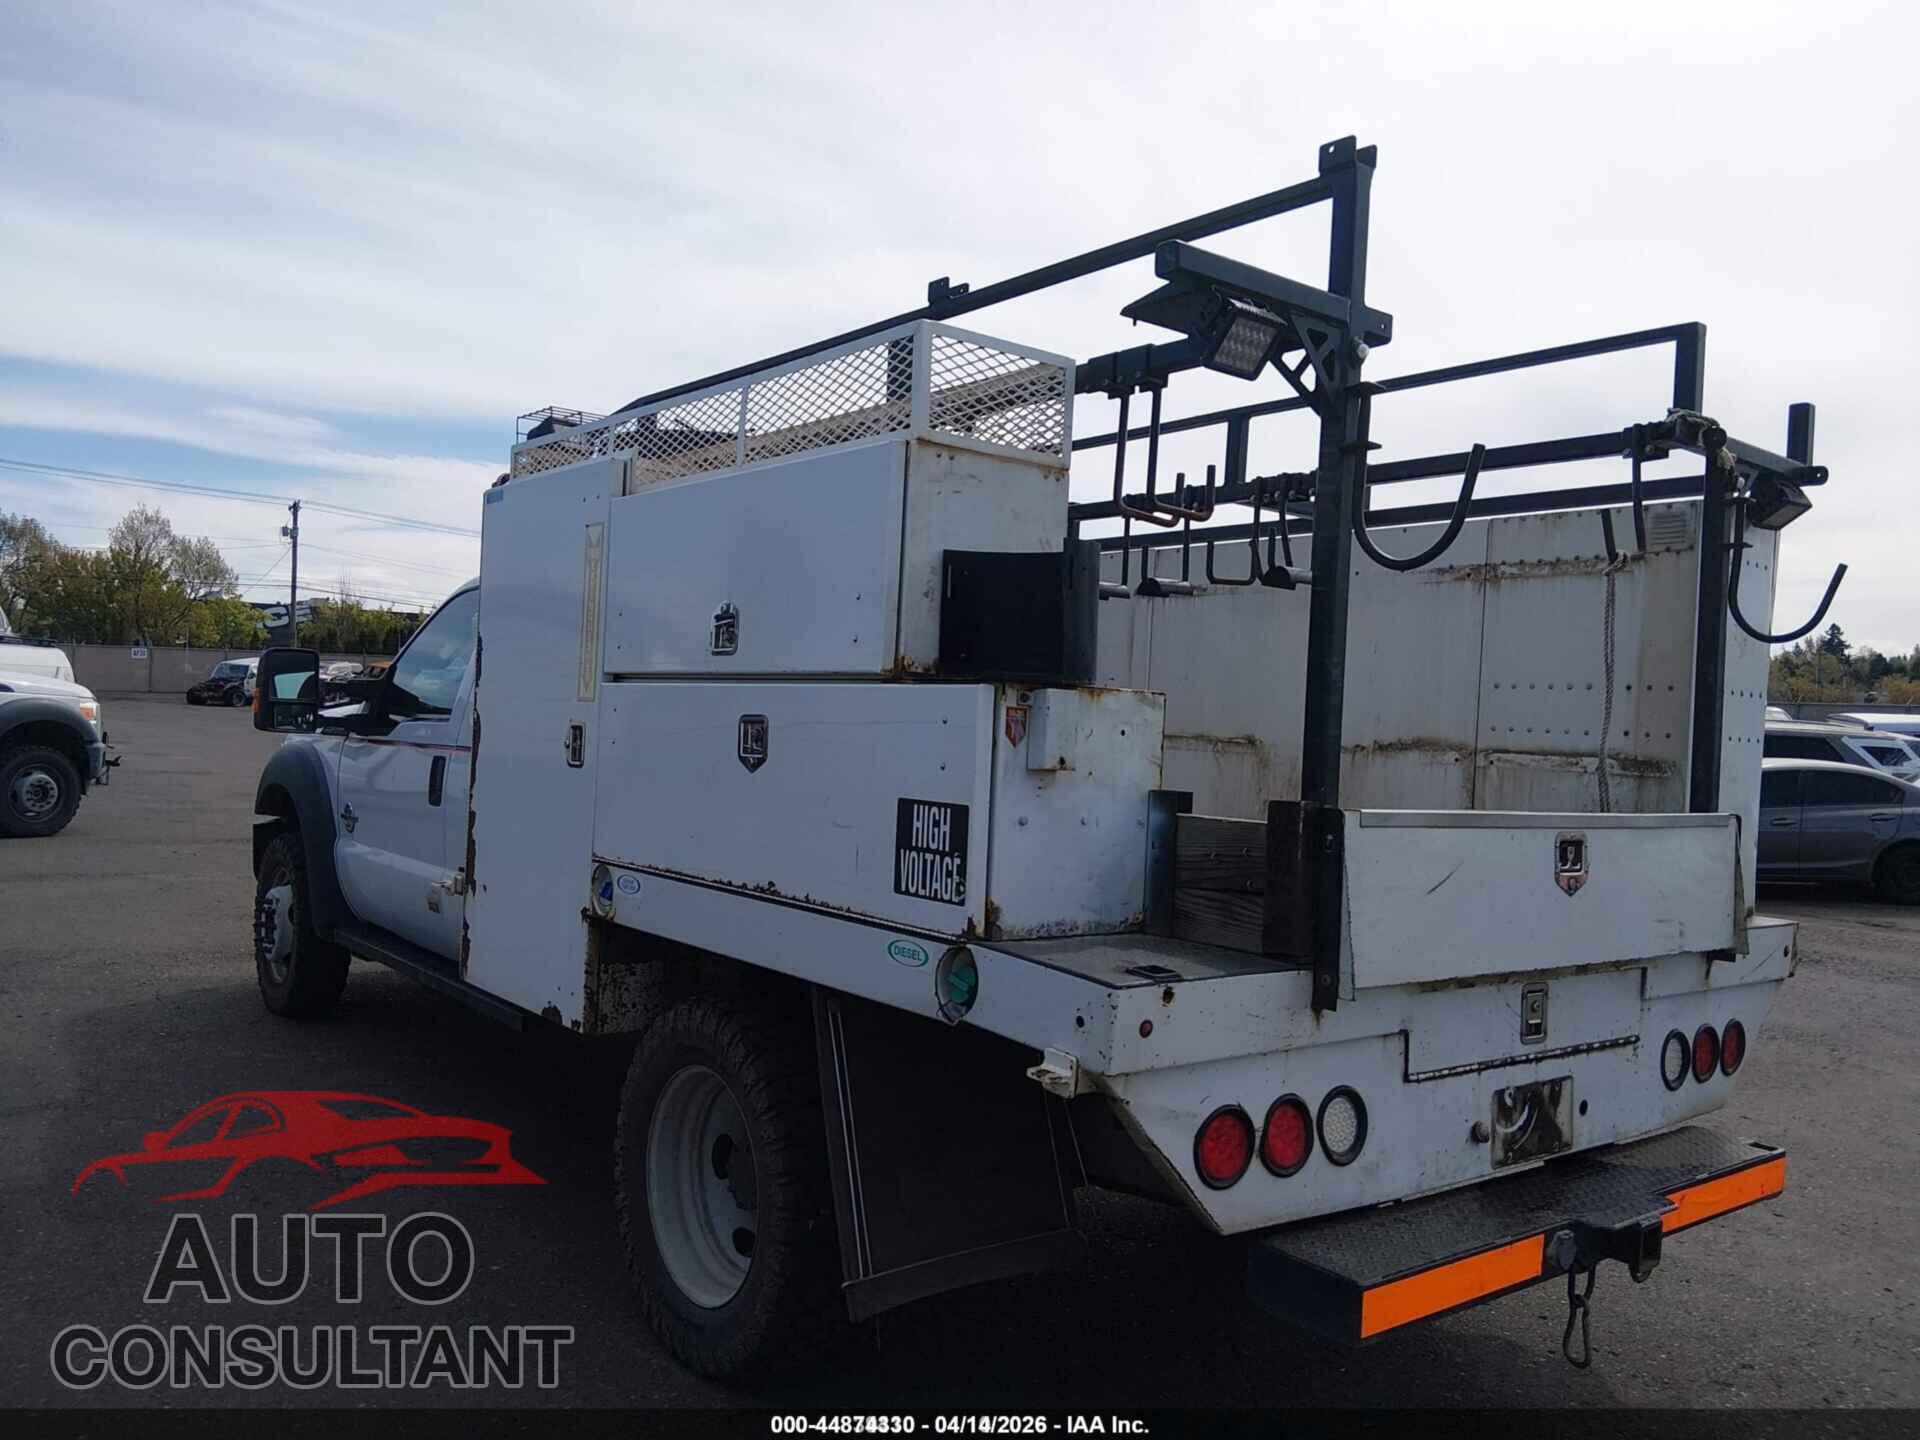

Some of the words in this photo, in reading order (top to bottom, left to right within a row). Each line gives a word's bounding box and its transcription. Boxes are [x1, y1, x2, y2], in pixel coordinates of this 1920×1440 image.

[912, 803, 951, 852] HIGH
[900, 848, 962, 903] VOLTAGE
[893, 945, 923, 962] DIESEL
